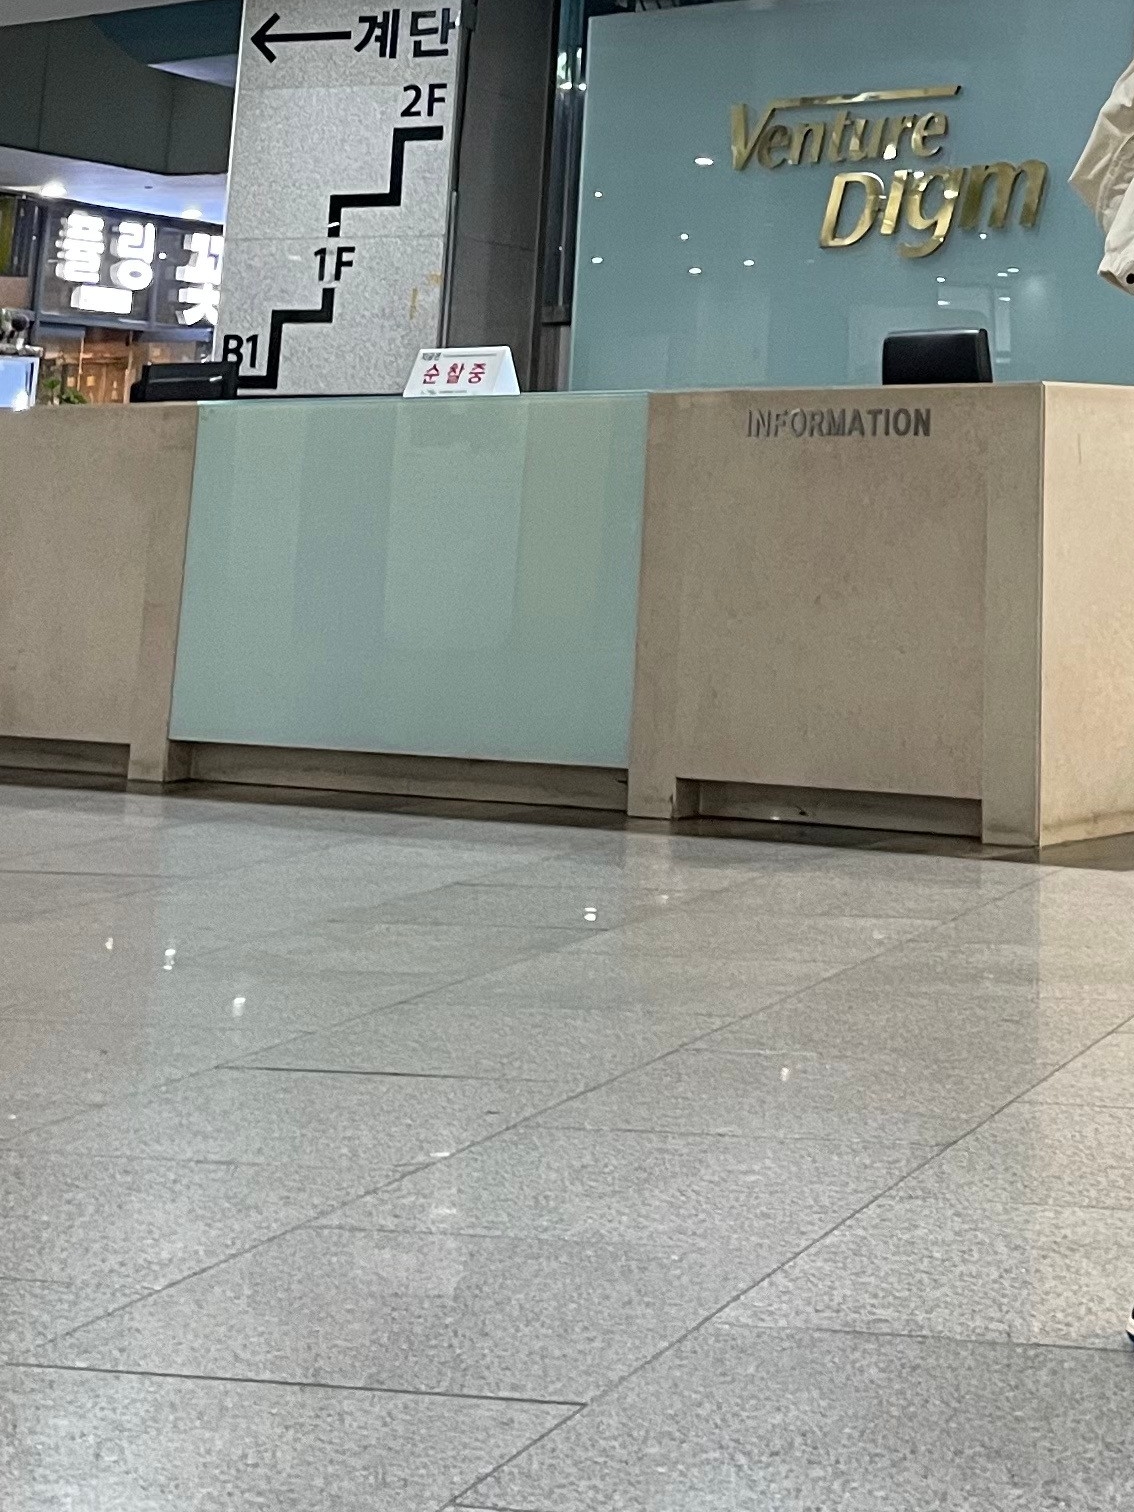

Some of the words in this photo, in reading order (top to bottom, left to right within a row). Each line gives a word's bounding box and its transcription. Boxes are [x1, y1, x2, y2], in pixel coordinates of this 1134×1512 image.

[354, 8, 456, 59] 계단
[401, 83, 447, 117] 2F
[731, 86, 961, 170] Venture
[314, 246, 356, 281] 1F
[223, 334, 258, 368] B1
[747, 408, 931, 438] INFORMATION
